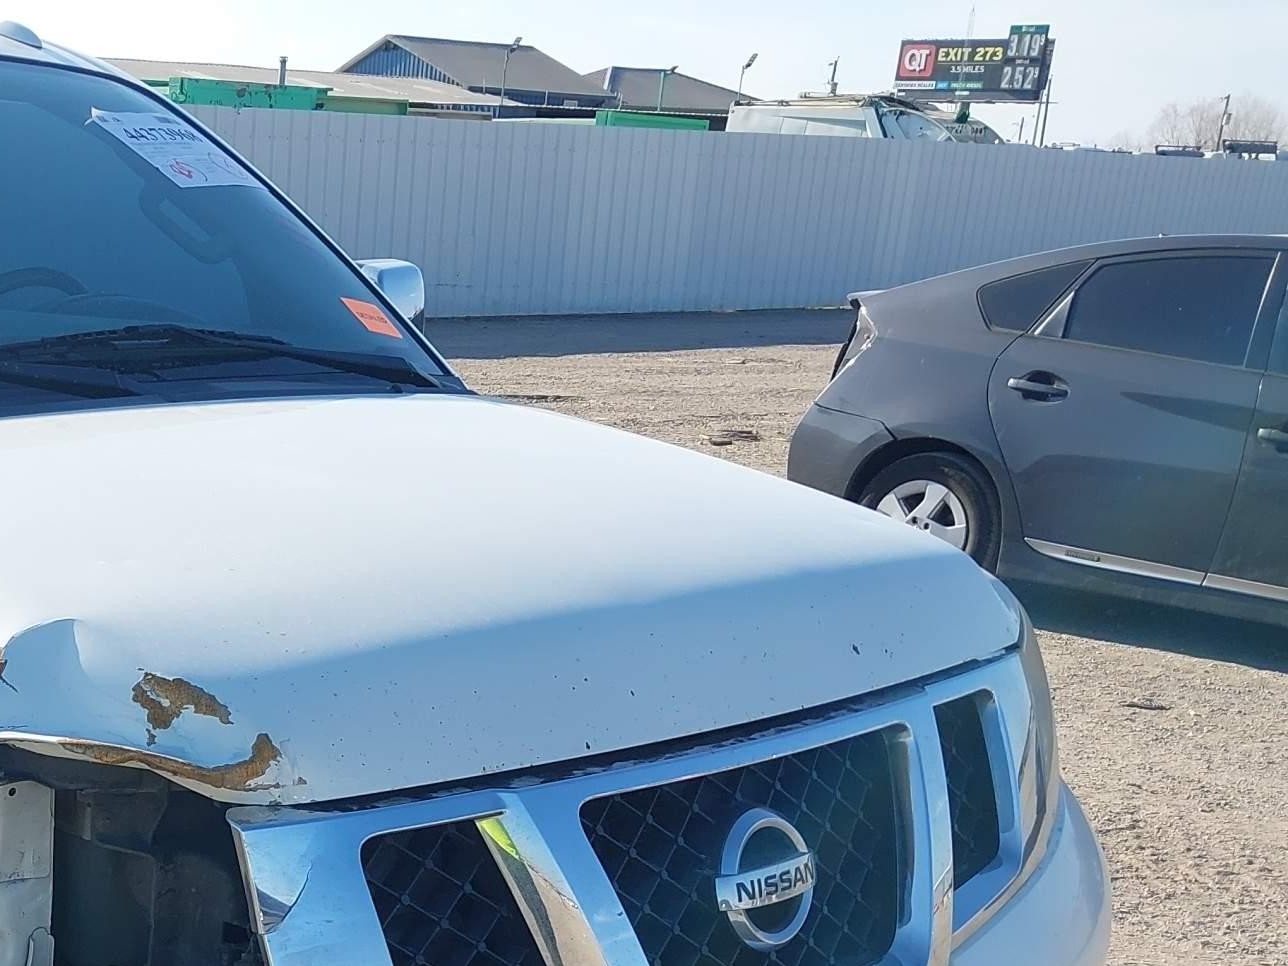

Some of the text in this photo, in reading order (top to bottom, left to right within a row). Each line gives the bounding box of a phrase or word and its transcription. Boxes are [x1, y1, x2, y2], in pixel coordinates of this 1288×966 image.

[904, 48, 930, 73] QT
[937, 47, 1004, 62] EXIT 273
[736, 862, 815, 903] NISSAN
